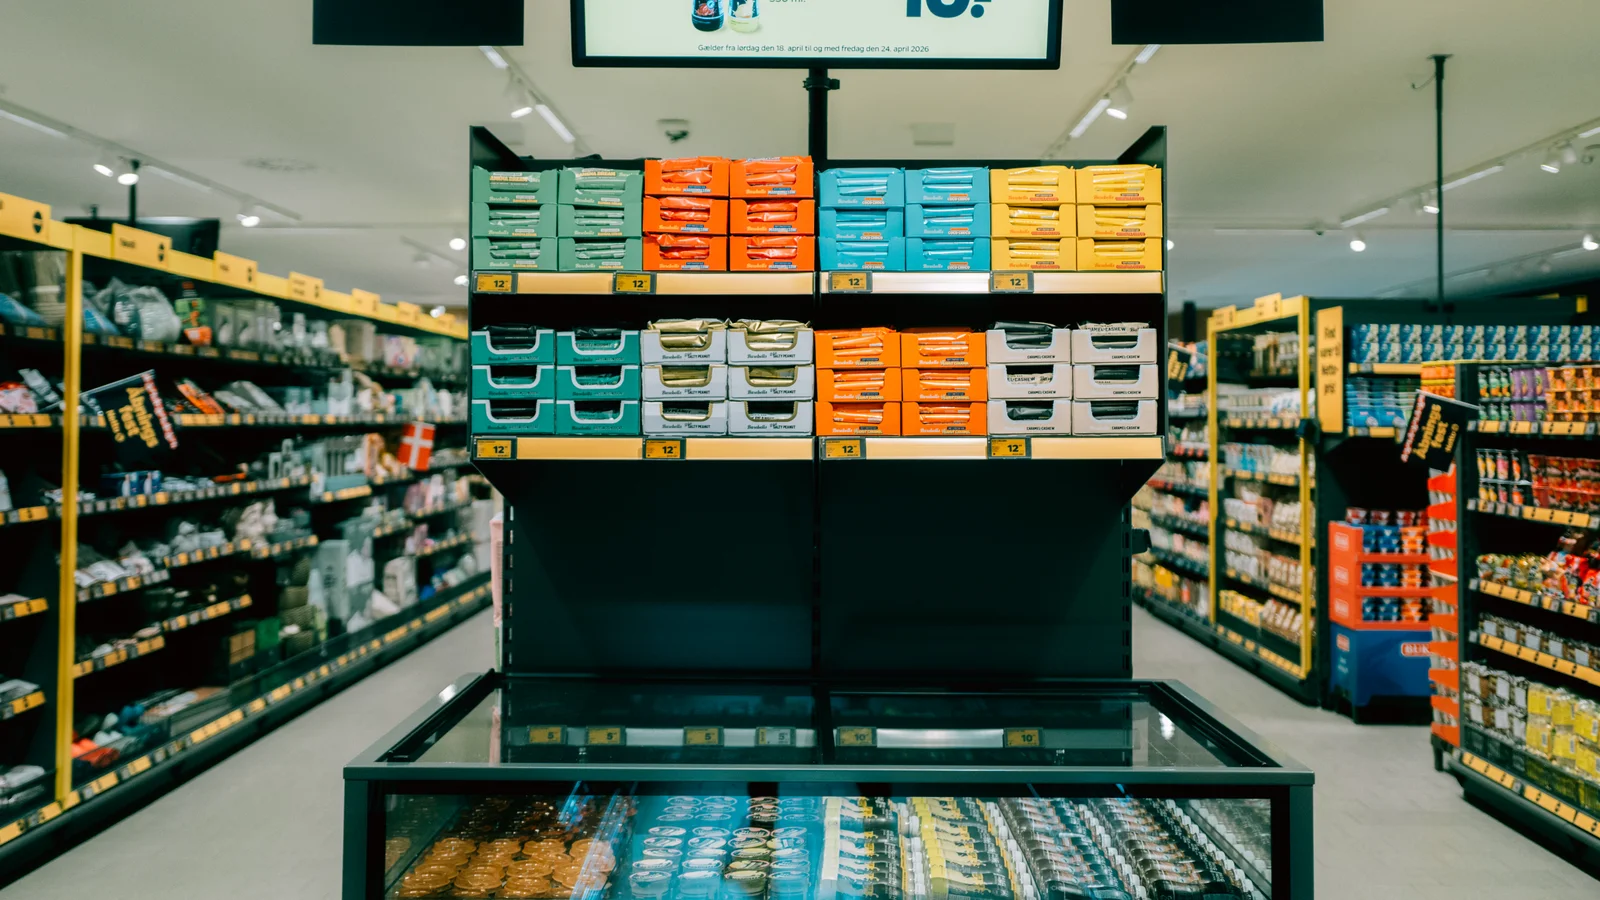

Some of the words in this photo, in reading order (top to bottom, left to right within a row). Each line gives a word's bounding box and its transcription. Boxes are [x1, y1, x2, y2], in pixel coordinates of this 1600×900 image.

[737, 45, 760, 53] lørdag
[787, 45, 804, 53] april
[841, 46, 865, 54] fredag
[494, 280, 504, 288] 12
[633, 280, 644, 288] 12
[849, 278, 860, 286] 12
[1010, 278, 1021, 286] 12
[118, 405, 140, 437] fest
[1431, 421, 1449, 449] fest
[494, 446, 504, 454] 12
[662, 446, 674, 454] 12
[842, 446, 853, 454] 12
[1008, 444, 1018, 452] 12
[607, 732, 613, 740] 5
[1021, 734, 1032, 742] 10
